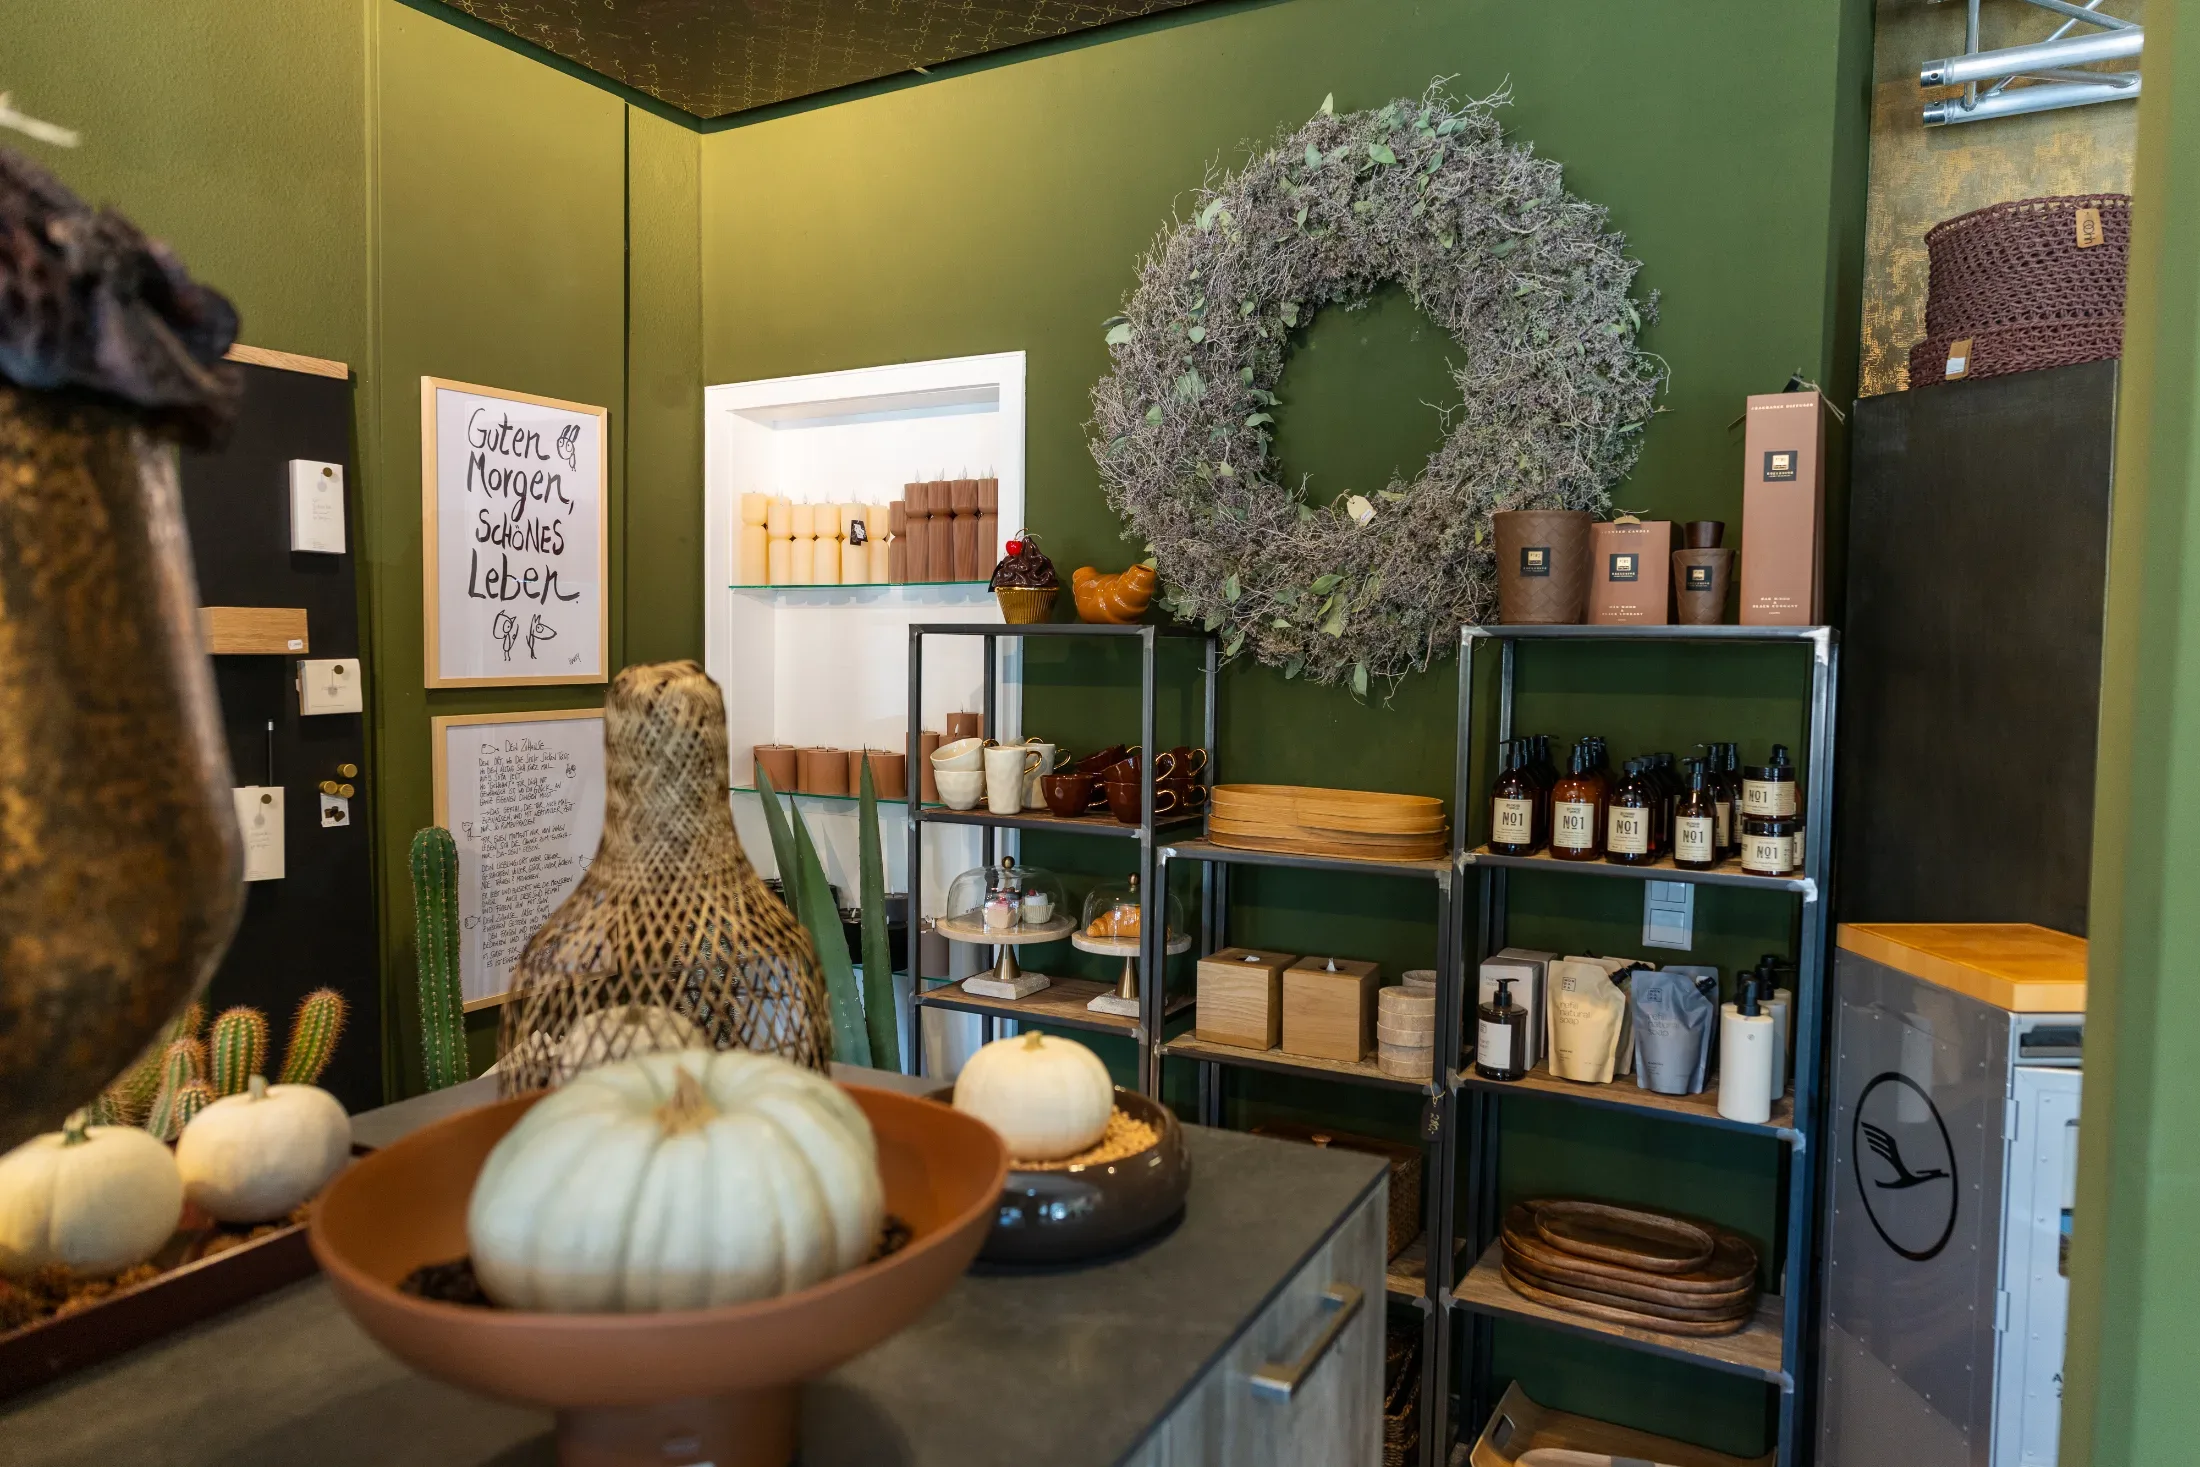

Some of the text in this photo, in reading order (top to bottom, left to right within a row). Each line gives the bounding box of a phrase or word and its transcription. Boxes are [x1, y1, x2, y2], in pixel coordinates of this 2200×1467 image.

[468, 408, 550, 460] Guten
[467, 450, 574, 522] Morgen,
[468, 548, 580, 605] Leben.
[1560, 1009, 1591, 1019] natural
[1560, 1017, 1579, 1026] soap
